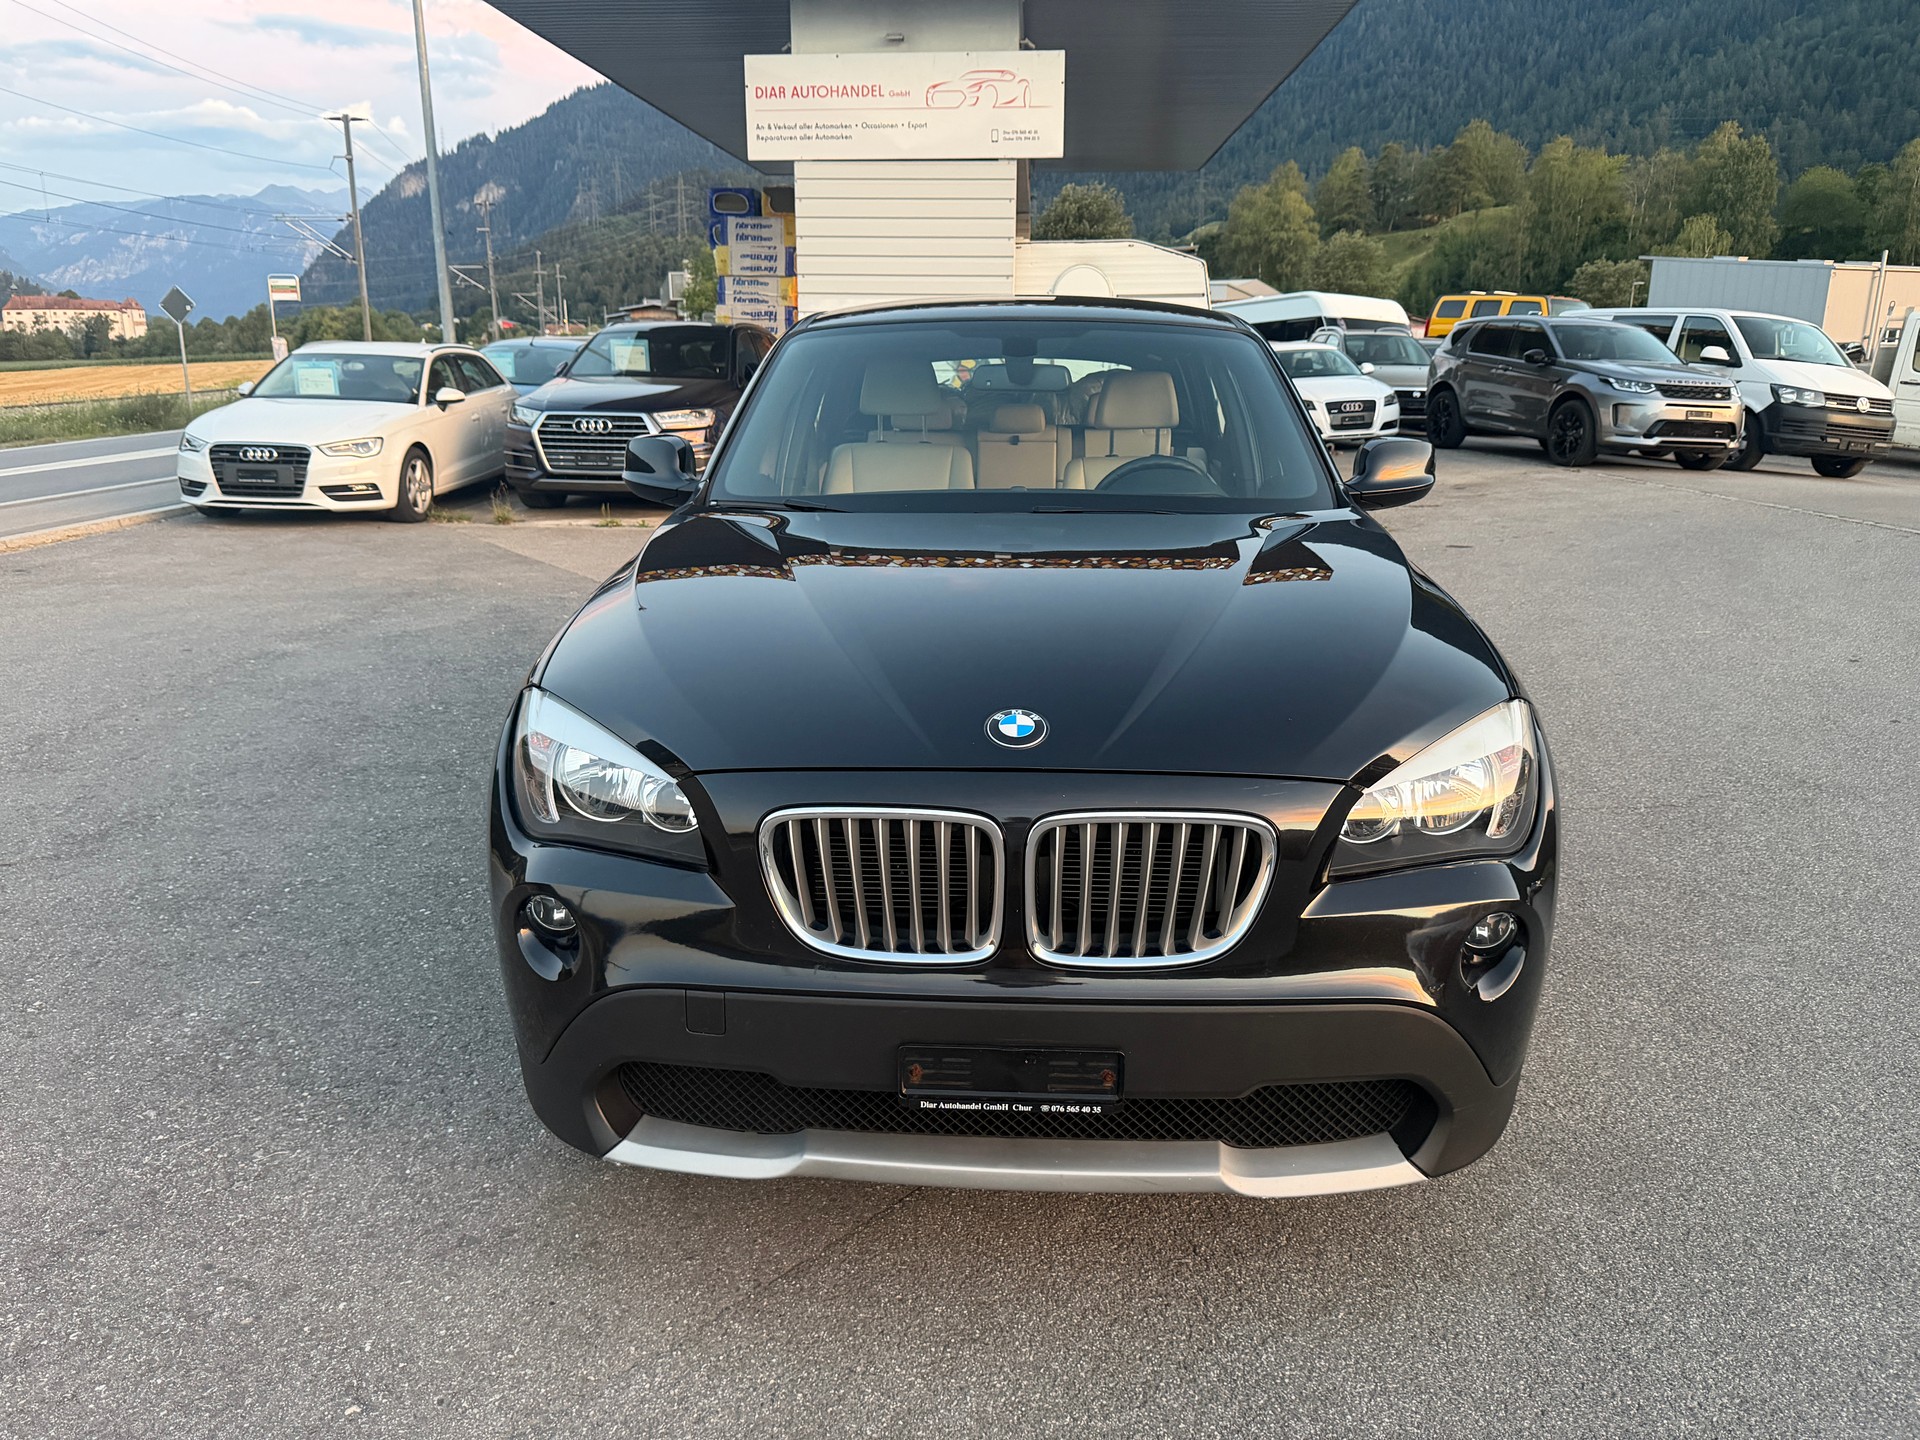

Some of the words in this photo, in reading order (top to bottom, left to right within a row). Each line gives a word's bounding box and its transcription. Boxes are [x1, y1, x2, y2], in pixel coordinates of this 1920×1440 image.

[755, 85, 786, 99] DIAR
[791, 84, 885, 98] AUTOHANDEL
[773, 122, 798, 130] Verkauf
[799, 122, 813, 130] aller
[814, 122, 853, 130] Automarken
[861, 121, 899, 129] Occasionen
[907, 121, 928, 130] Export
[756, 133, 798, 143] Reparaturen
[799, 133, 813, 141] aller
[815, 133, 853, 141] Automarken
[993, 709, 1041, 720] BMW
[920, 1101, 938, 1109] Diar
[938, 1101, 982, 1110] Autohandel
[983, 1103, 1009, 1111] GmbH
[1012, 1103, 1033, 1111] Chur
[1066, 1105, 1080, 1113] 565
[1092, 1106, 1102, 1114] 35
